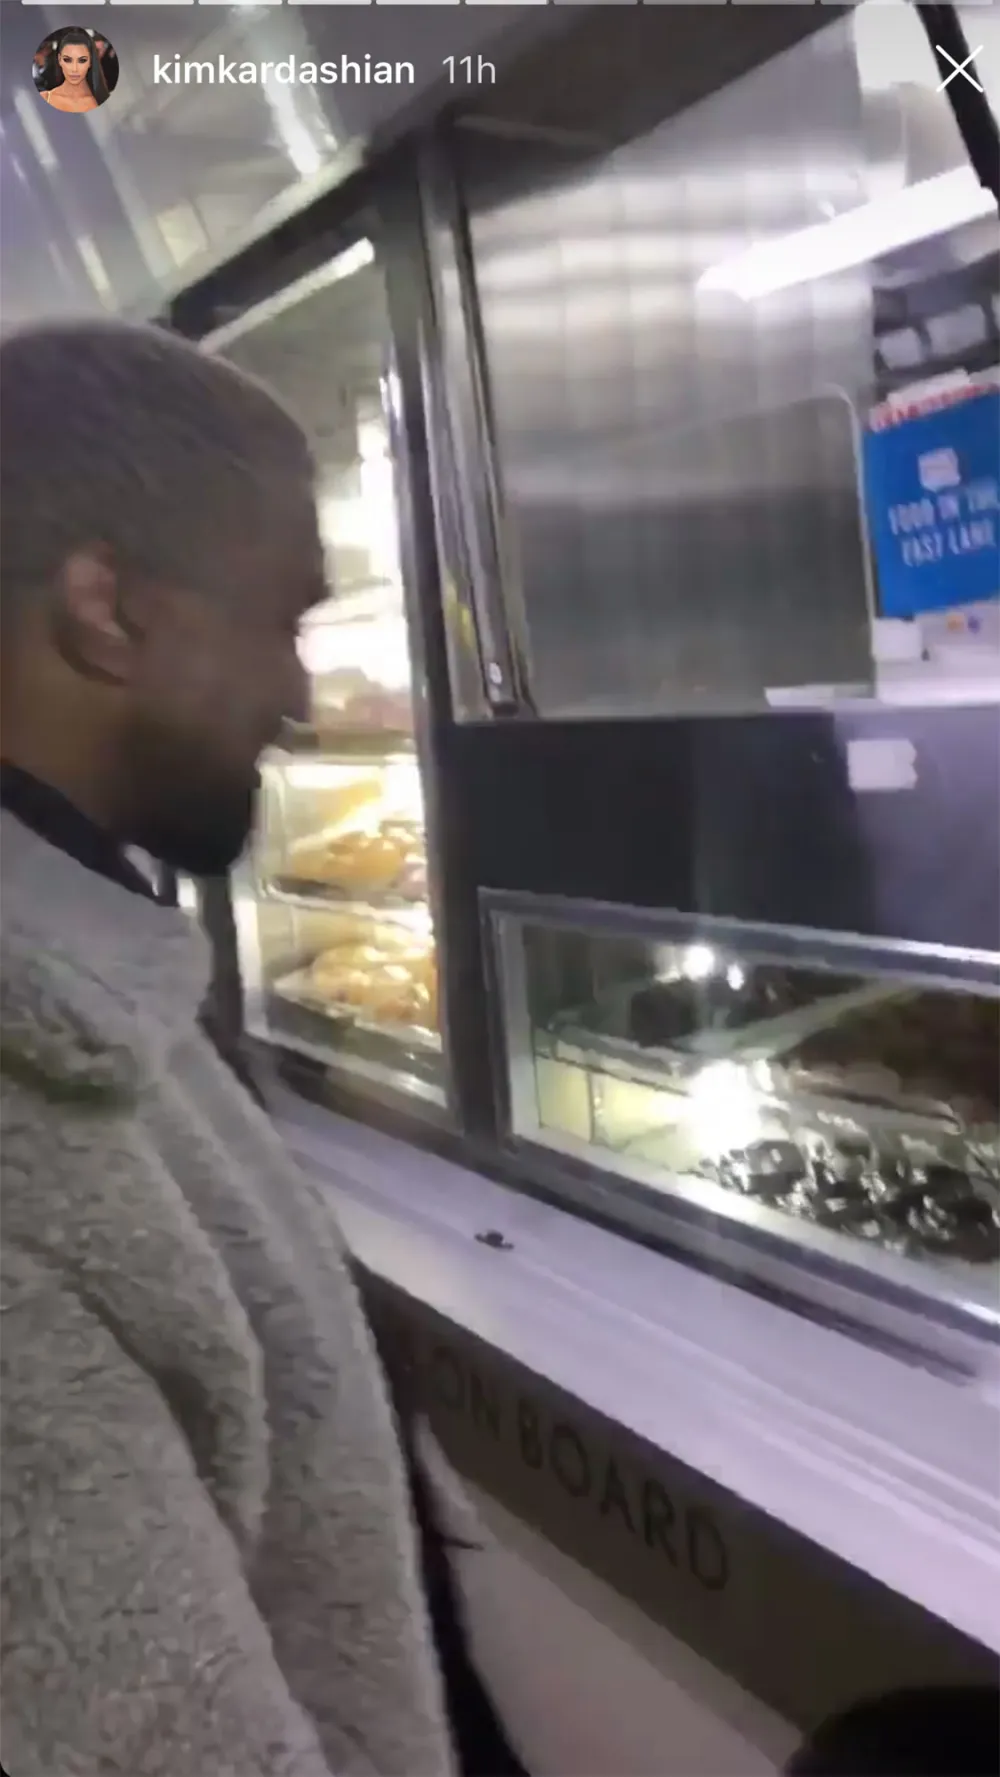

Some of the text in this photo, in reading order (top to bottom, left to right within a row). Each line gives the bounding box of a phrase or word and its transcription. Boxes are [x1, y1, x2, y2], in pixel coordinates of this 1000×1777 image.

[887, 497, 936, 535] FOOD
[901, 531, 943, 568] FAST
[517, 1397, 731, 1591] BOARD
